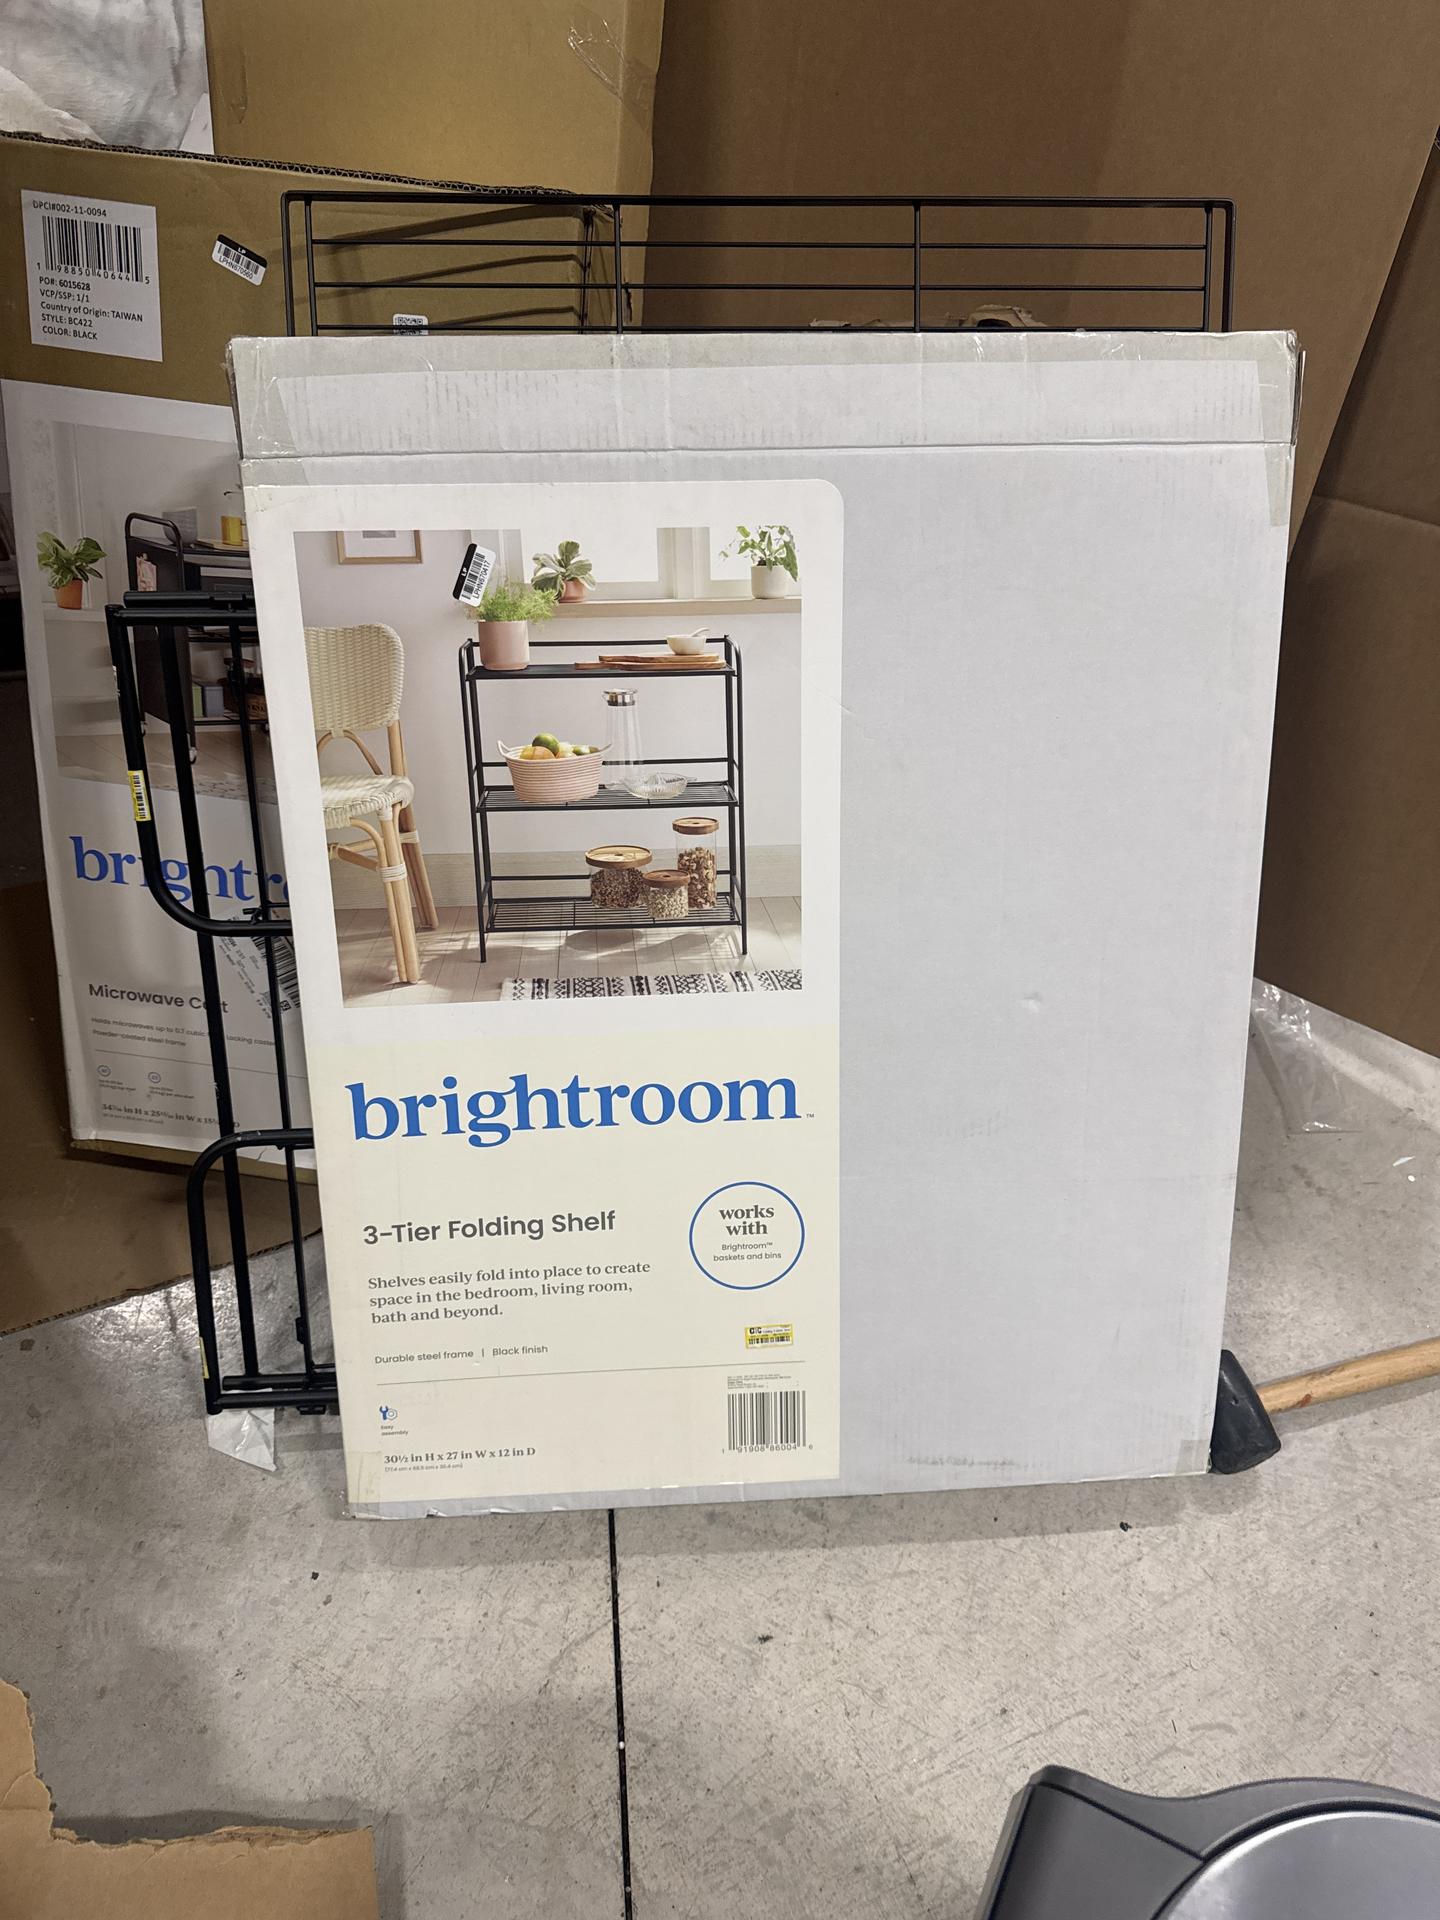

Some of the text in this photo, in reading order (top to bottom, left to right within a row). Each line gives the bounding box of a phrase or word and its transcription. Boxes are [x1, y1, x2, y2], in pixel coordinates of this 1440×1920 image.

[56, 264, 91, 277] 98850
[96, 270, 131, 282] 40644
[144, 275, 150, 285] 5
[39, 276, 91, 292] PO#: 6015628
[76, 294, 90, 304] 1/1
[40, 301, 143, 323] Country of Origin: TAIWAN
[41, 313, 93, 328] STYLE: BC422
[42, 325, 98, 341] COLOR: BLACK
[461, 567, 469, 577] LP
[88, 983, 229, 1014] Microwave Ct
[345, 1073, 803, 1148] brightroom
[719, 1205, 775, 1220] works
[363, 1210, 616, 1245] 3-Tier Folding Shelf
[726, 1221, 768, 1236] with
[713, 1254, 745, 1262] baskets
[368, 1262, 651, 1290] Shelves easily fold into place to create
[369, 1281, 633, 1309] space in the bedroom, living room,
[371, 1304, 504, 1324] bath and beyond.
[374, 1354, 415, 1364] Durable
[417, 1352, 442, 1361] steel
[443, 1350, 474, 1359] frame
[492, 1347, 519, 1356] Black
[521, 1345, 548, 1355] finish
[411, 1454, 423, 1462] in
[425, 1453, 435, 1462] H
[446, 1451, 458, 1460] 27
[460, 1451, 473, 1459] in
[475, 1450, 487, 1458] W
[498, 1448, 510, 1457] 12
[512, 1448, 524, 1456] in
[526, 1447, 536, 1456] D
